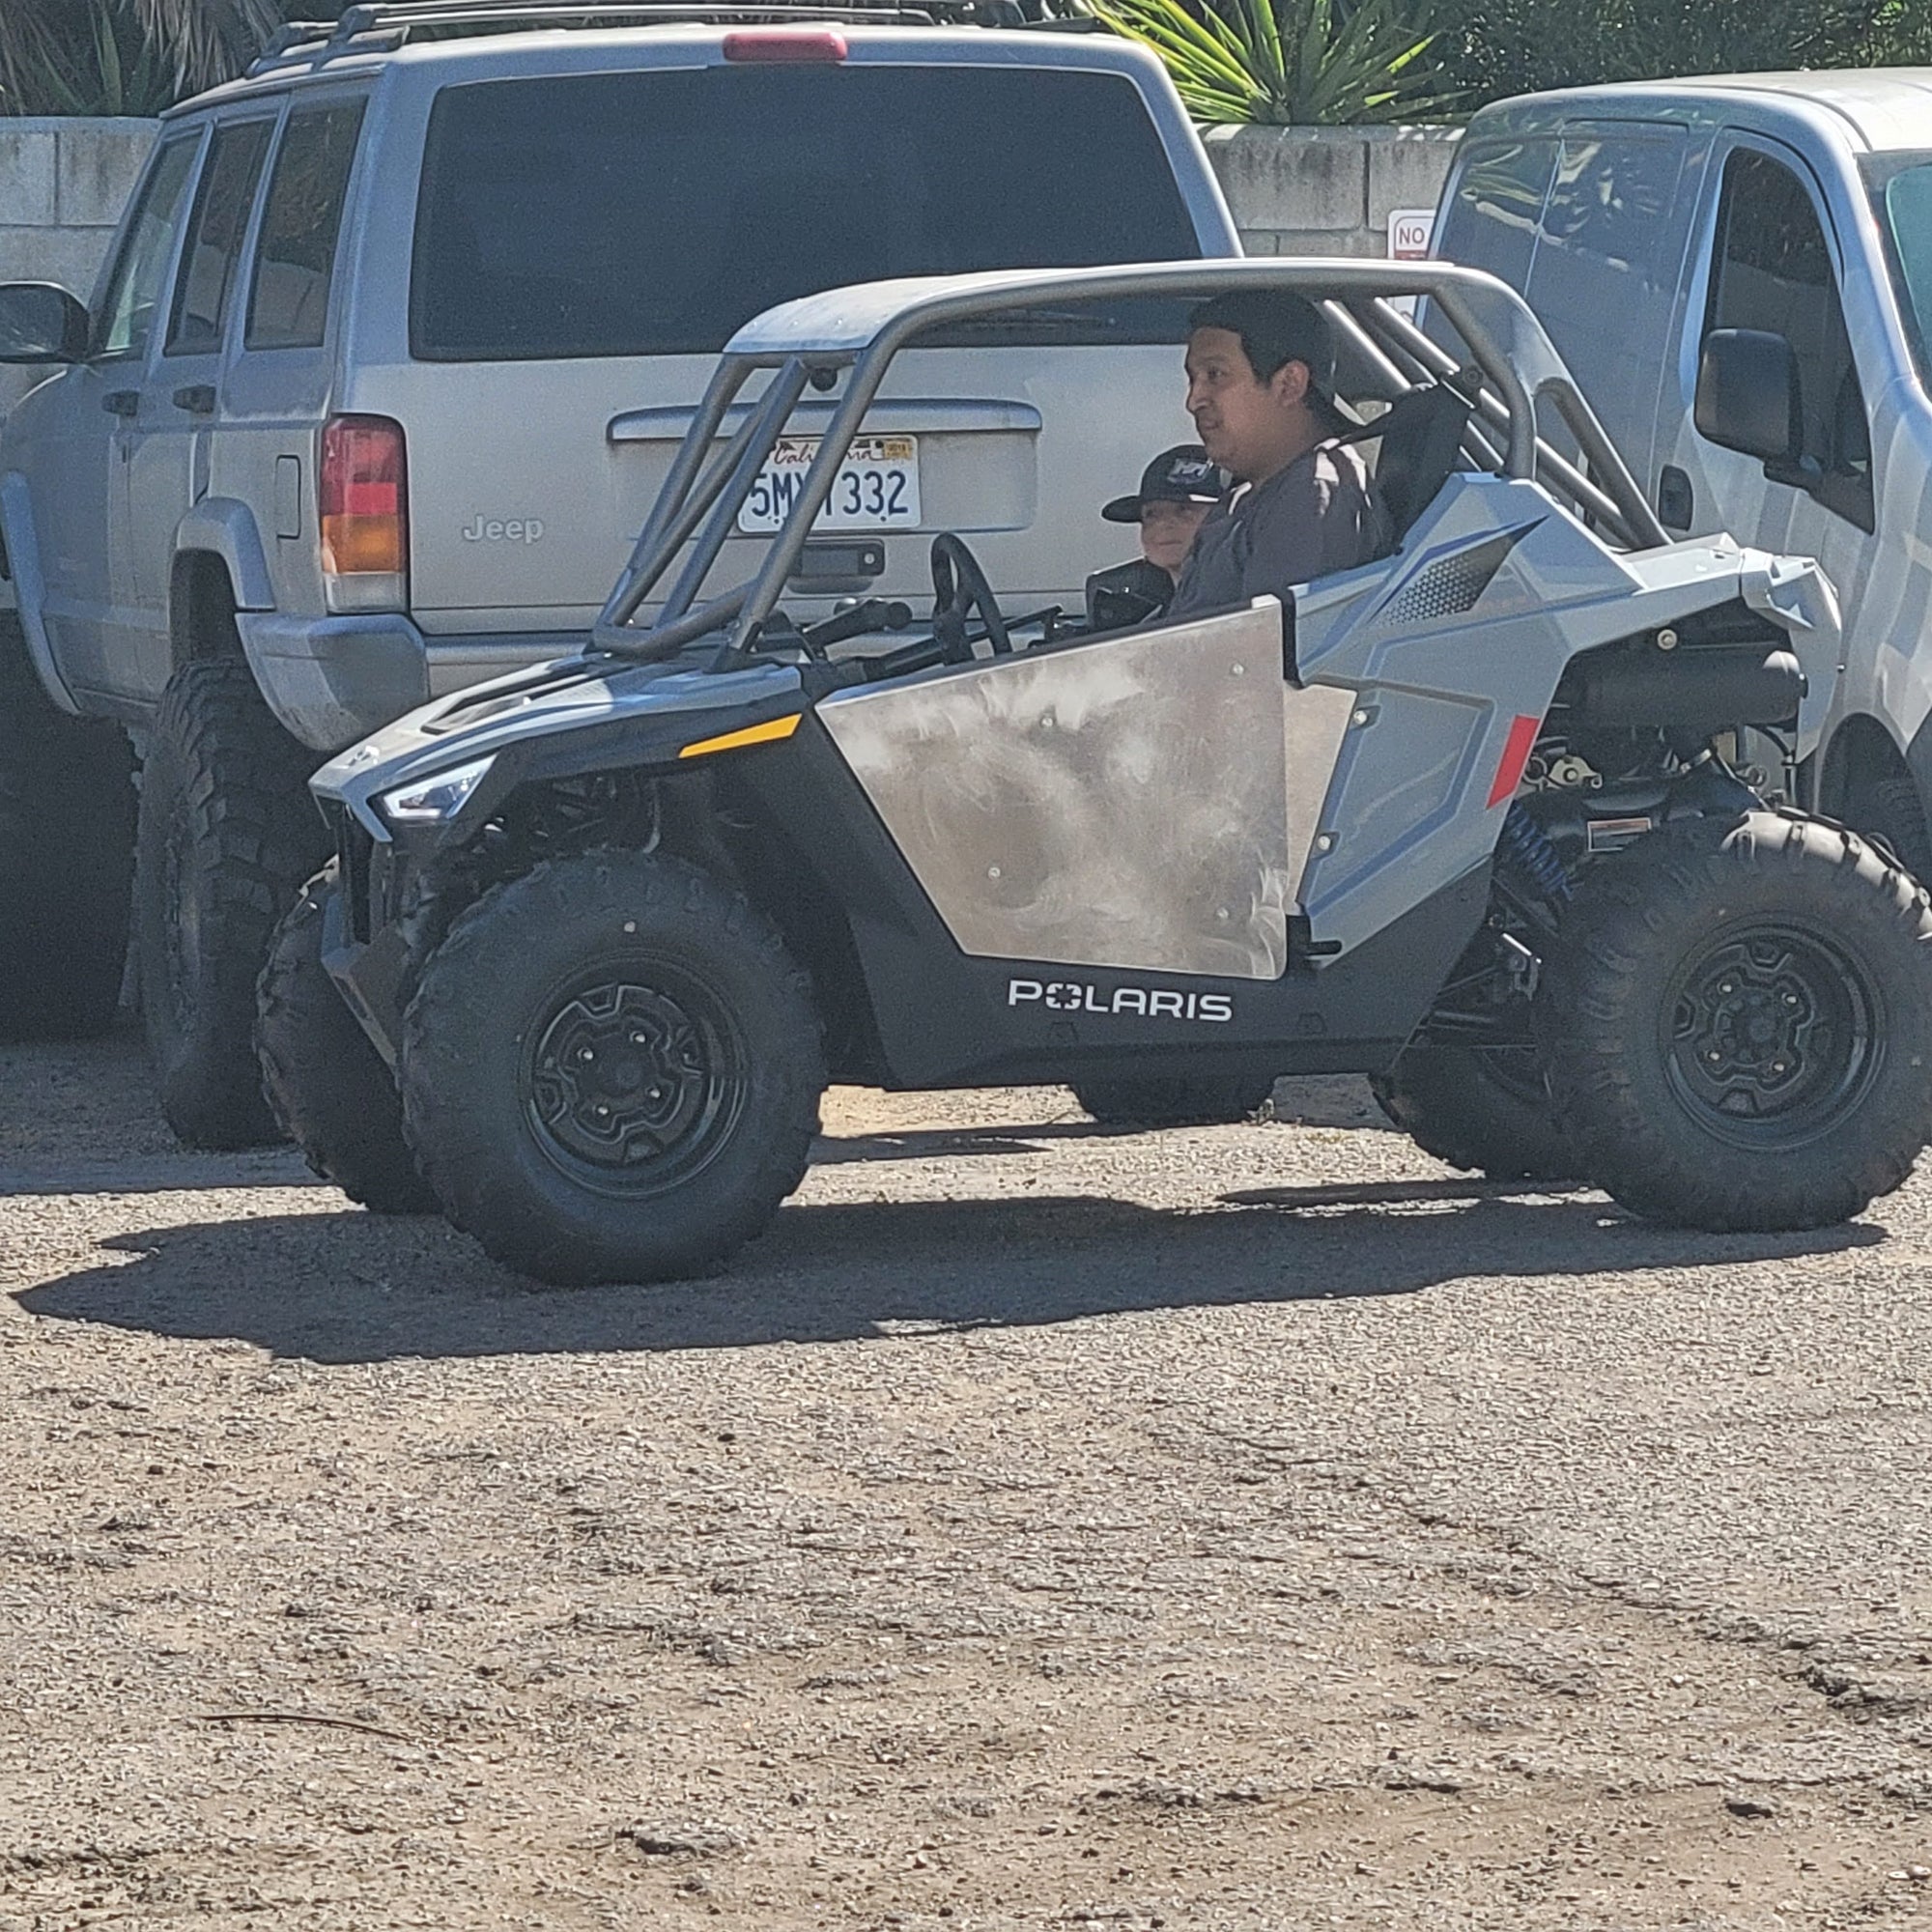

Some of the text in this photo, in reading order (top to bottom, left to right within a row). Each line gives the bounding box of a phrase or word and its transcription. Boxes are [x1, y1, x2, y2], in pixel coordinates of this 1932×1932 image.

[1399, 226, 1425, 244] NO
[774, 441, 882, 464] Caliia
[464, 514, 543, 544] Jeep
[1008, 980, 1233, 1022] POLARIS
